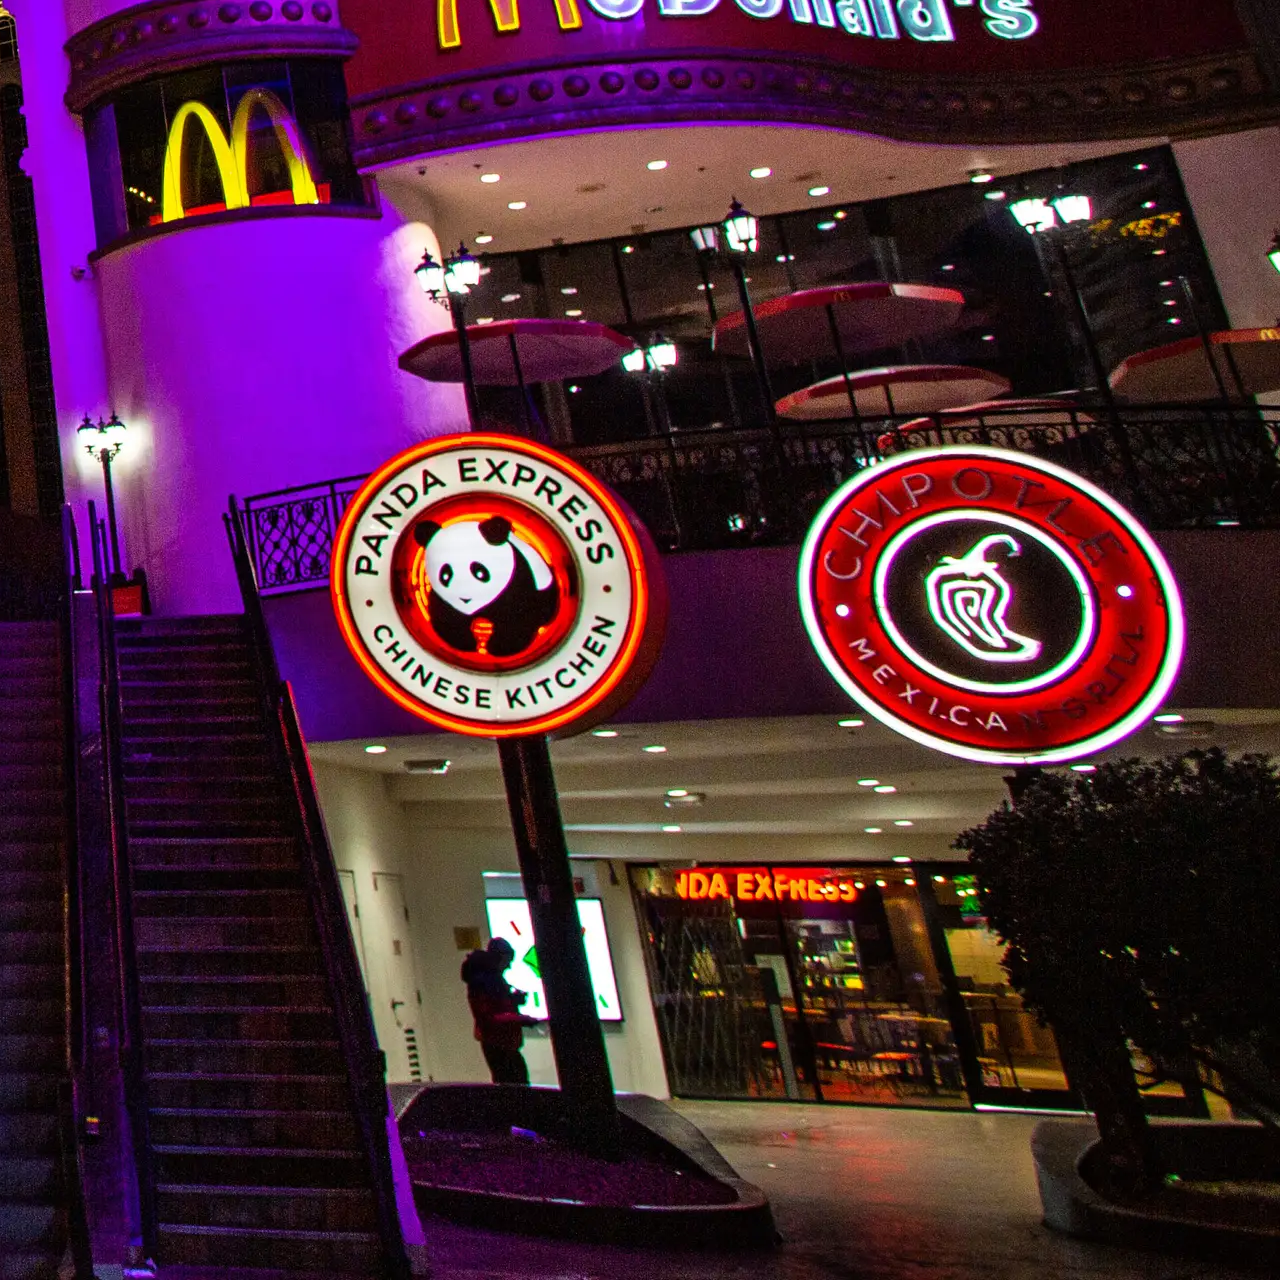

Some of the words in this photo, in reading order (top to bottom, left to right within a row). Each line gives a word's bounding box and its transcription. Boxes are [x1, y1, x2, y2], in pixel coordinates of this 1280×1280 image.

[356, 468, 446, 577] PANDA
[458, 457, 614, 565] EXPRESS
[824, 467, 1128, 581] CHIPOTLE
[373, 624, 492, 709] CHINESE
[505, 615, 617, 710] KITCHEN
